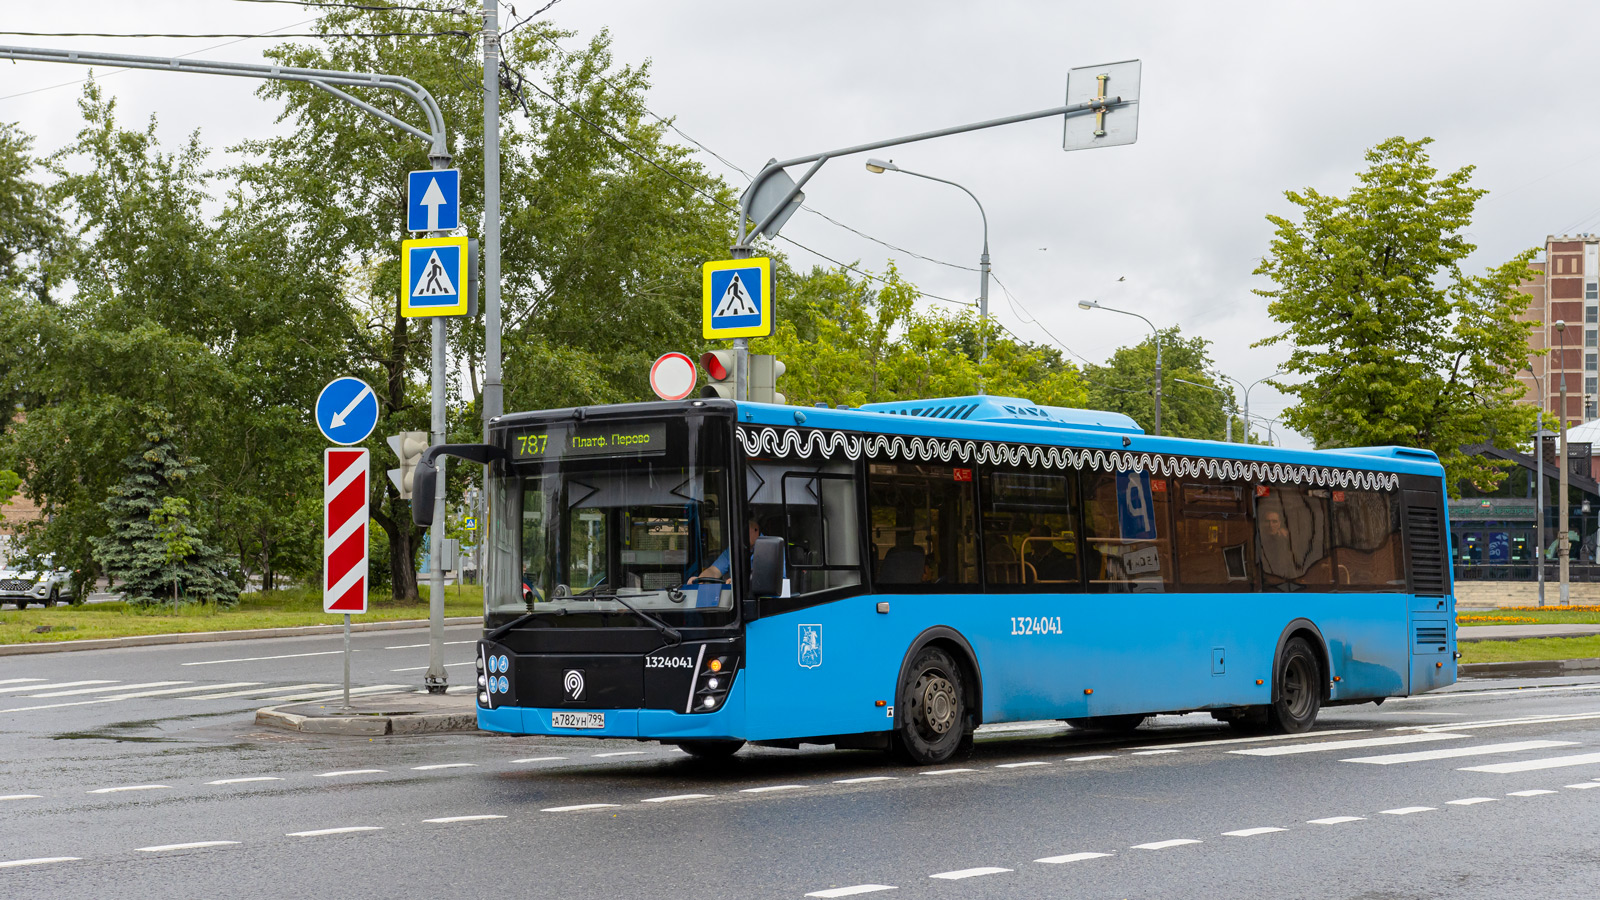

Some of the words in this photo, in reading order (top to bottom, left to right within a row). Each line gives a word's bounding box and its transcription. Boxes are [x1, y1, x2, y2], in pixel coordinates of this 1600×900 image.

[517, 435, 548, 455] 787
[572, 436, 608, 448] Платф.
[611, 433, 650, 446] Перово
[1010, 616, 1063, 635] 1324041
[645, 656, 693, 668] 1324041
